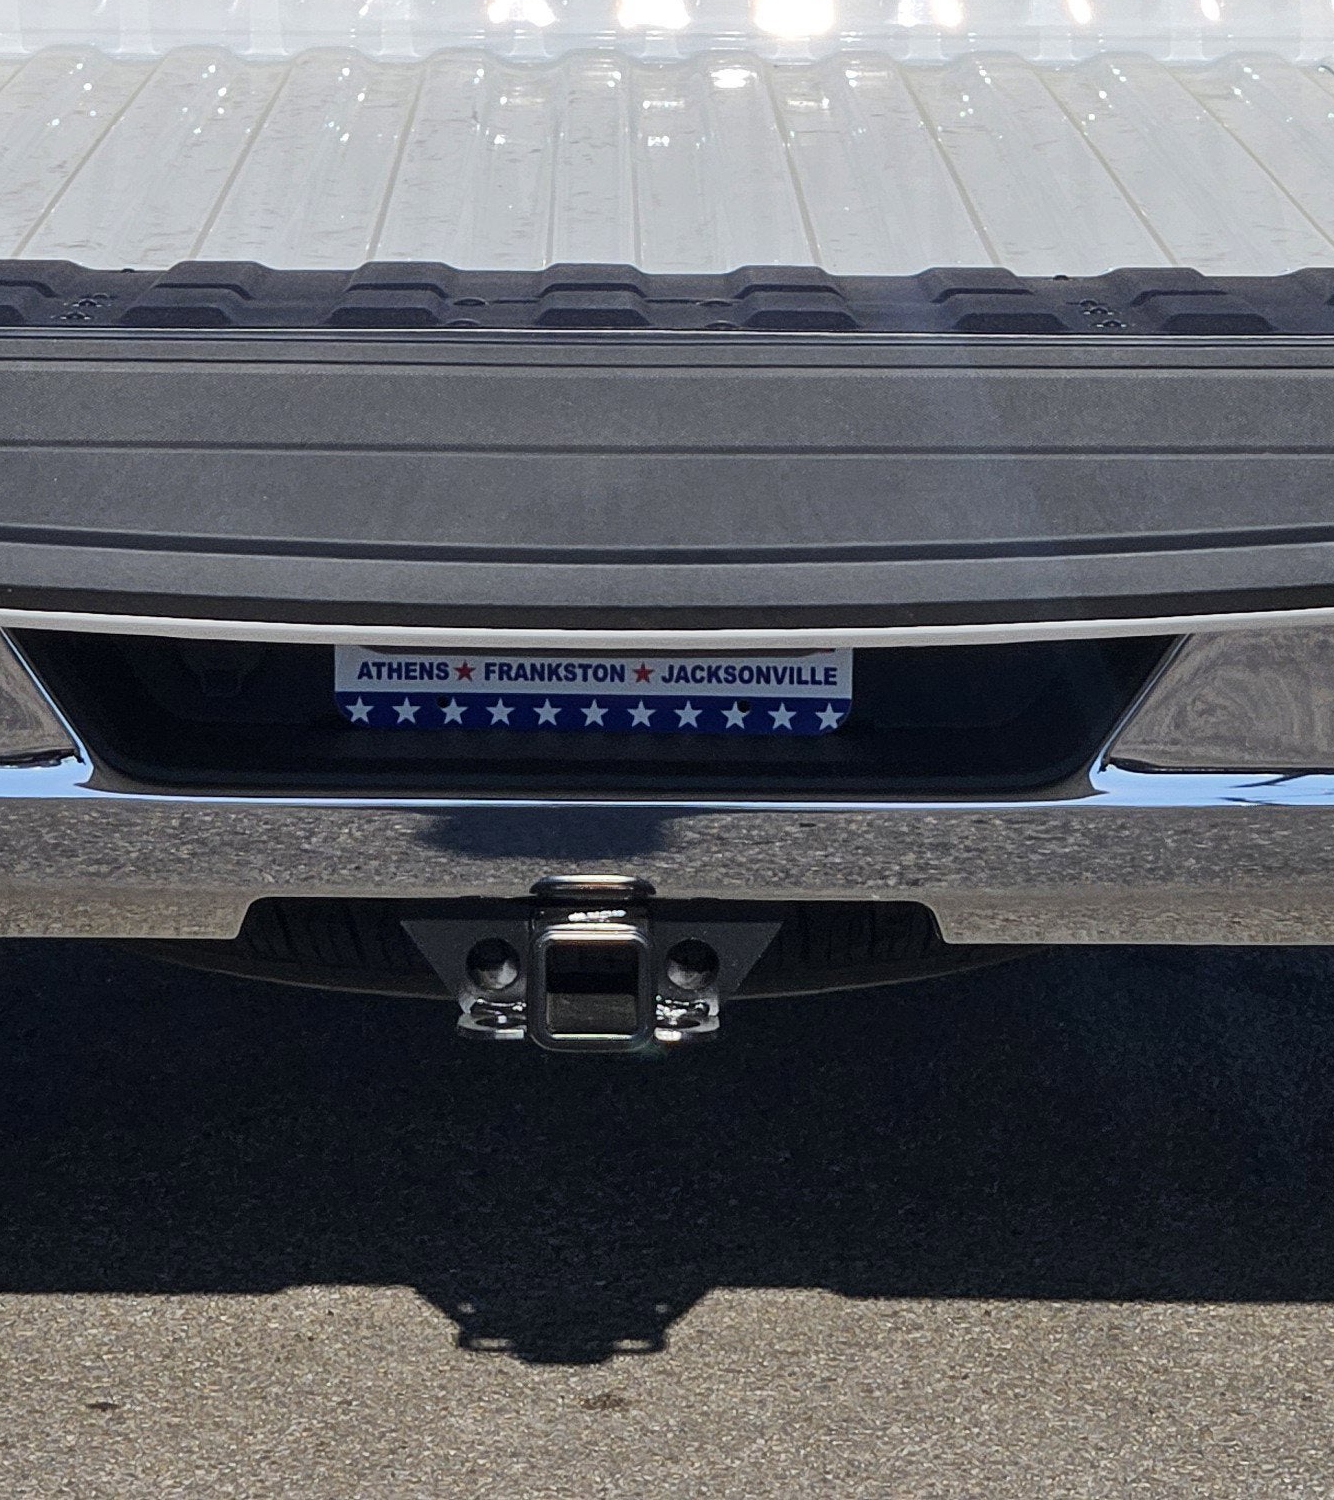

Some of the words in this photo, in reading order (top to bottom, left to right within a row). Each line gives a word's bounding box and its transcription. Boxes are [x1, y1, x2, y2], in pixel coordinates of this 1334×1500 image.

[357, 661, 450, 681] ATHENS
[483, 662, 626, 683] FRANKSTON
[661, 664, 838, 686] JACKSONVILLE
